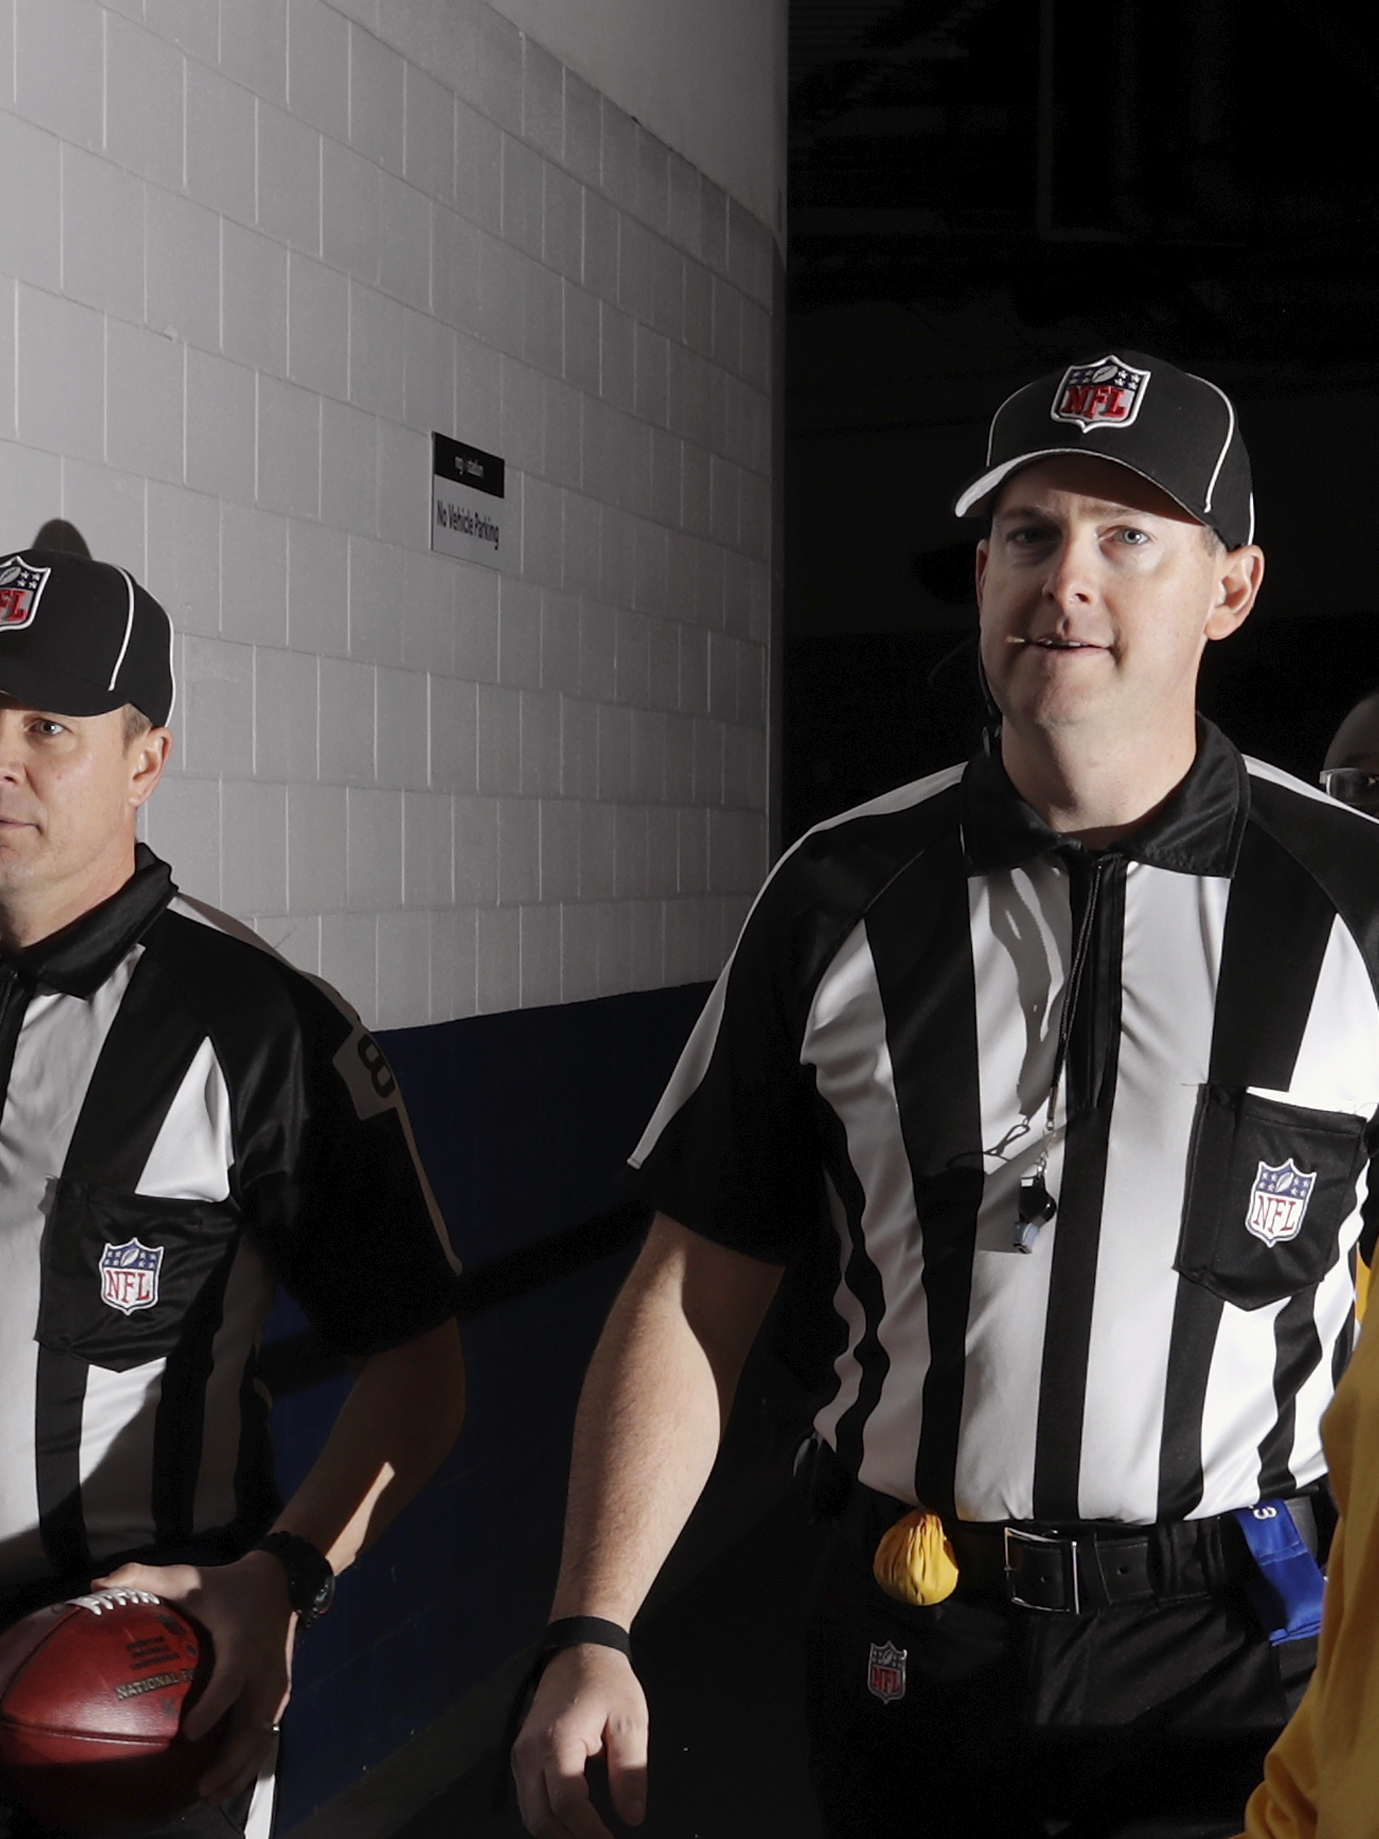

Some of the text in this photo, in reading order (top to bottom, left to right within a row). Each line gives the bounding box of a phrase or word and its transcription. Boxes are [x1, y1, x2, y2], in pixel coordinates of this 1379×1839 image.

[1061, 384, 1127, 420] NFL
[437, 500, 499, 550] No Vehicle Parking
[1253, 1195, 1296, 1233] NFL
[105, 1270, 150, 1304] NFL
[115, 1672, 180, 1700] NATIONAL
[871, 1666, 902, 1695] NFL
